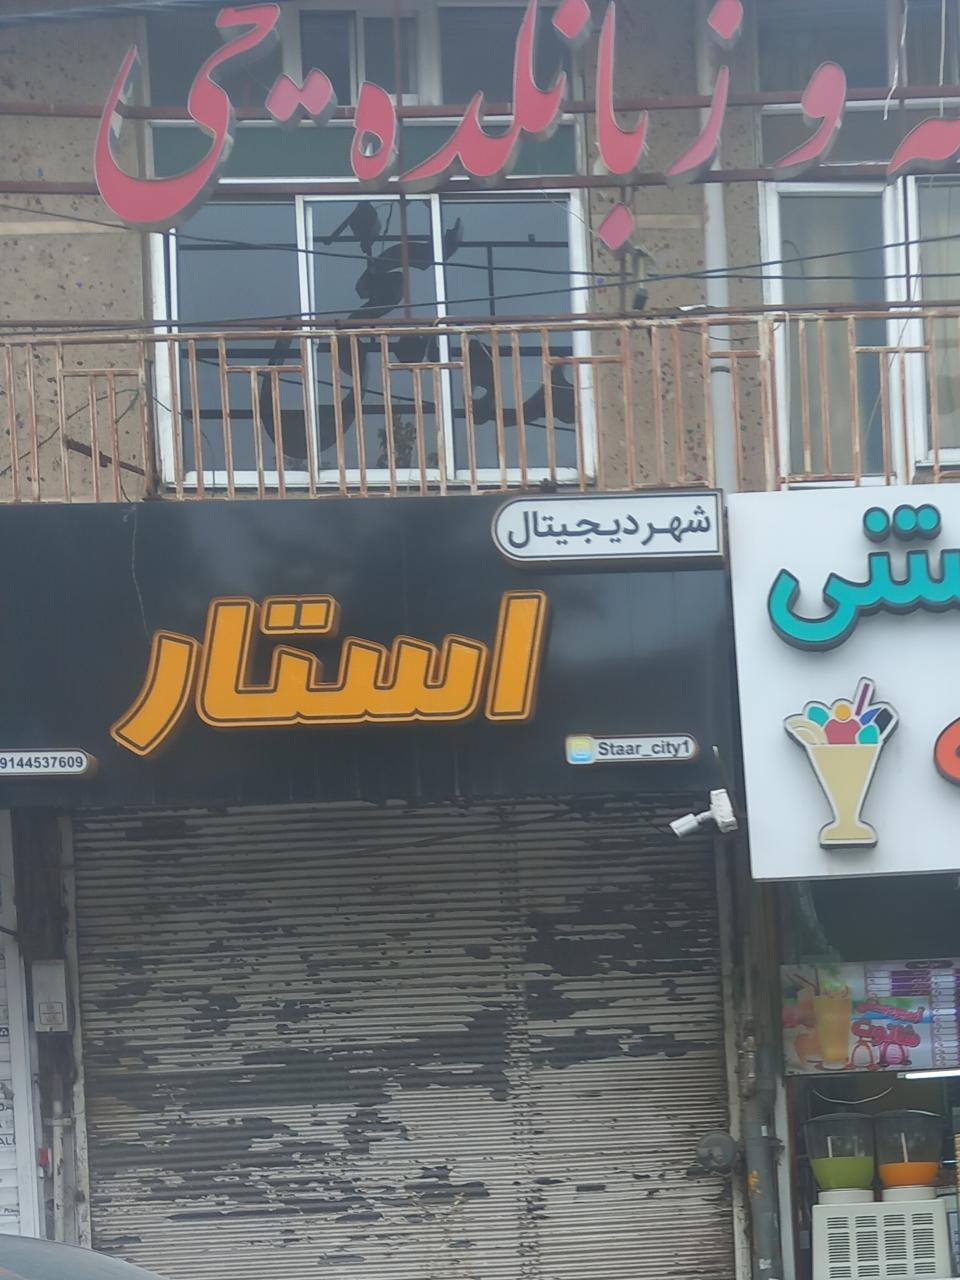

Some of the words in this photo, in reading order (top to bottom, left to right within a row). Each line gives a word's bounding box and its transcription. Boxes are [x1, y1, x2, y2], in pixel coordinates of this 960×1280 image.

[772, 60, 847, 170] و
[507, 509, 640, 549] دیجیتال
[641, 504, 712, 547] شهر
[110, 589, 547, 756] استار
[0, 755, 84, 769] 9144537609
[597, 738, 690, 758] Staar_city1
